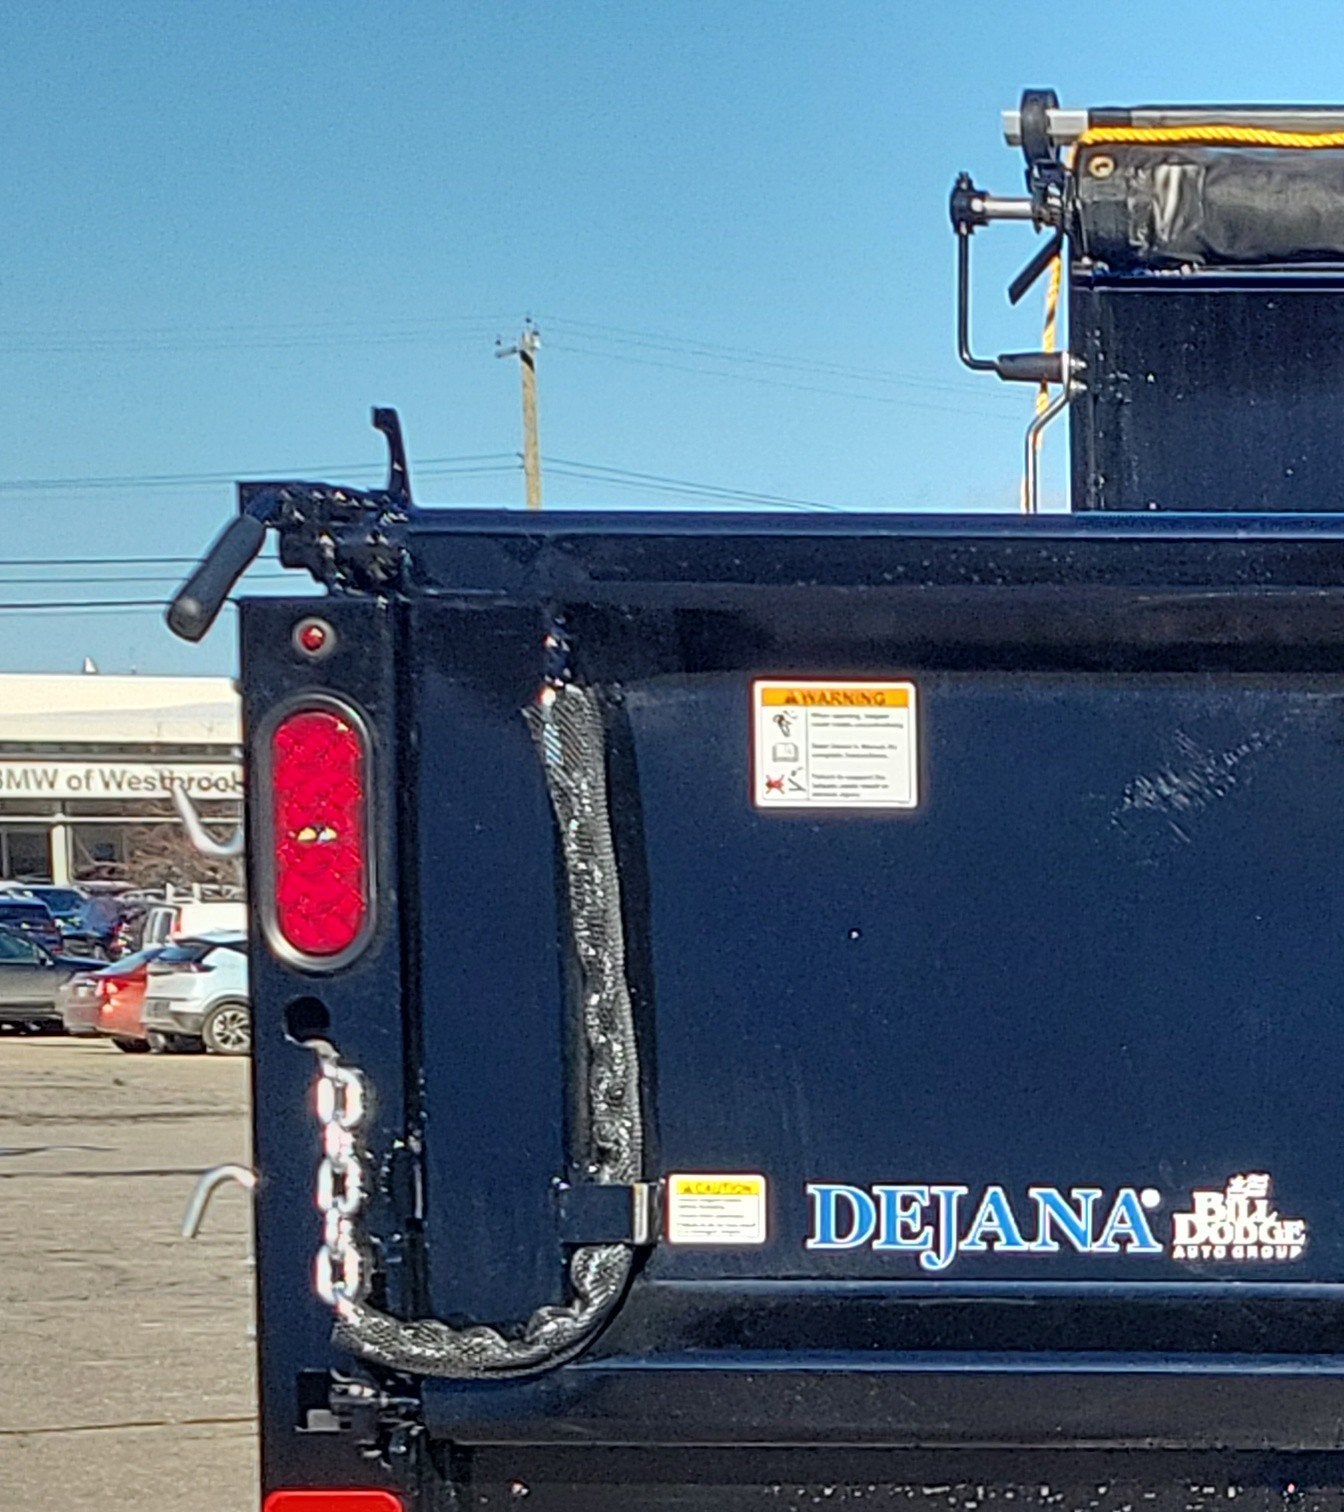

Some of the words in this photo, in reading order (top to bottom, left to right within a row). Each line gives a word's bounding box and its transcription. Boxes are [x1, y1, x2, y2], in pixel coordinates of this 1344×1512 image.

[801, 691, 886, 706] WARNING
[0, 768, 59, 791] MW
[66, 768, 92, 791] of
[805, 1183, 1163, 1271] DEJANA
[1172, 1212, 1307, 1246] DODGE
[1172, 1245, 1227, 1259] AUTO
[1231, 1245, 1303, 1259] GROUP
